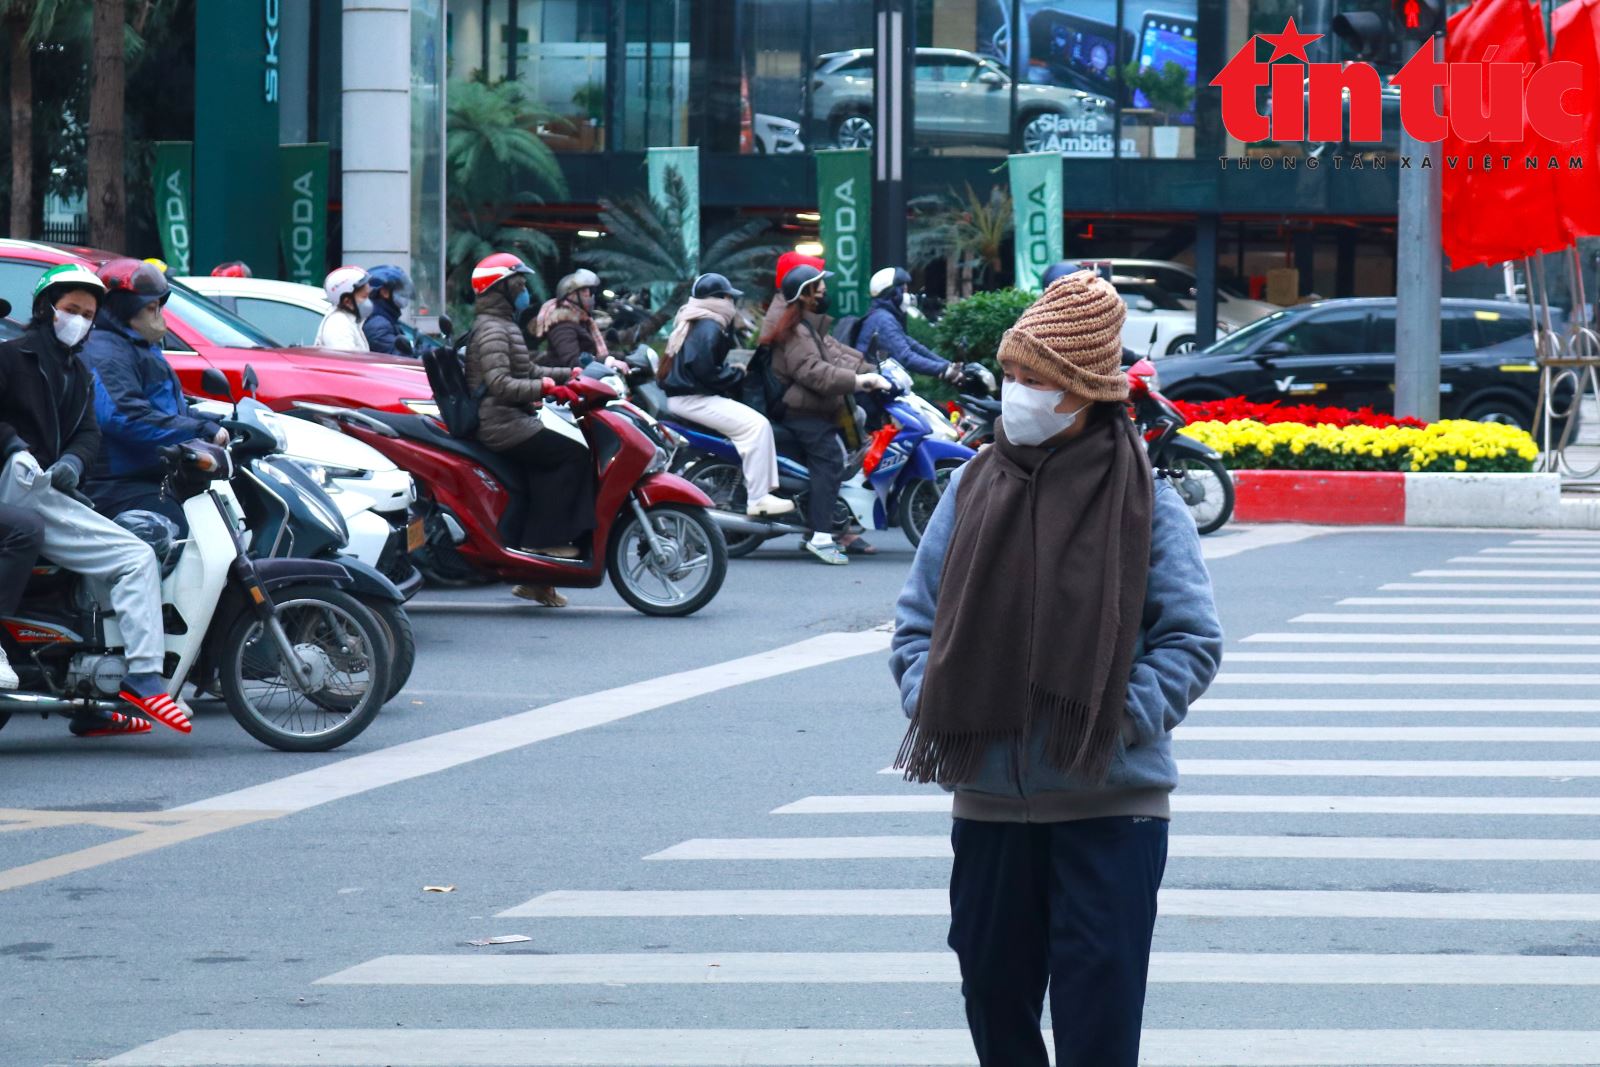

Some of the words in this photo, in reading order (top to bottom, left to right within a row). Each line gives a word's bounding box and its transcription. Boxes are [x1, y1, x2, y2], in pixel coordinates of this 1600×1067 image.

[1039, 113, 1097, 132] Slavia
[1045, 134, 1137, 151] Ambitin
[292, 170, 313, 286] KODA
